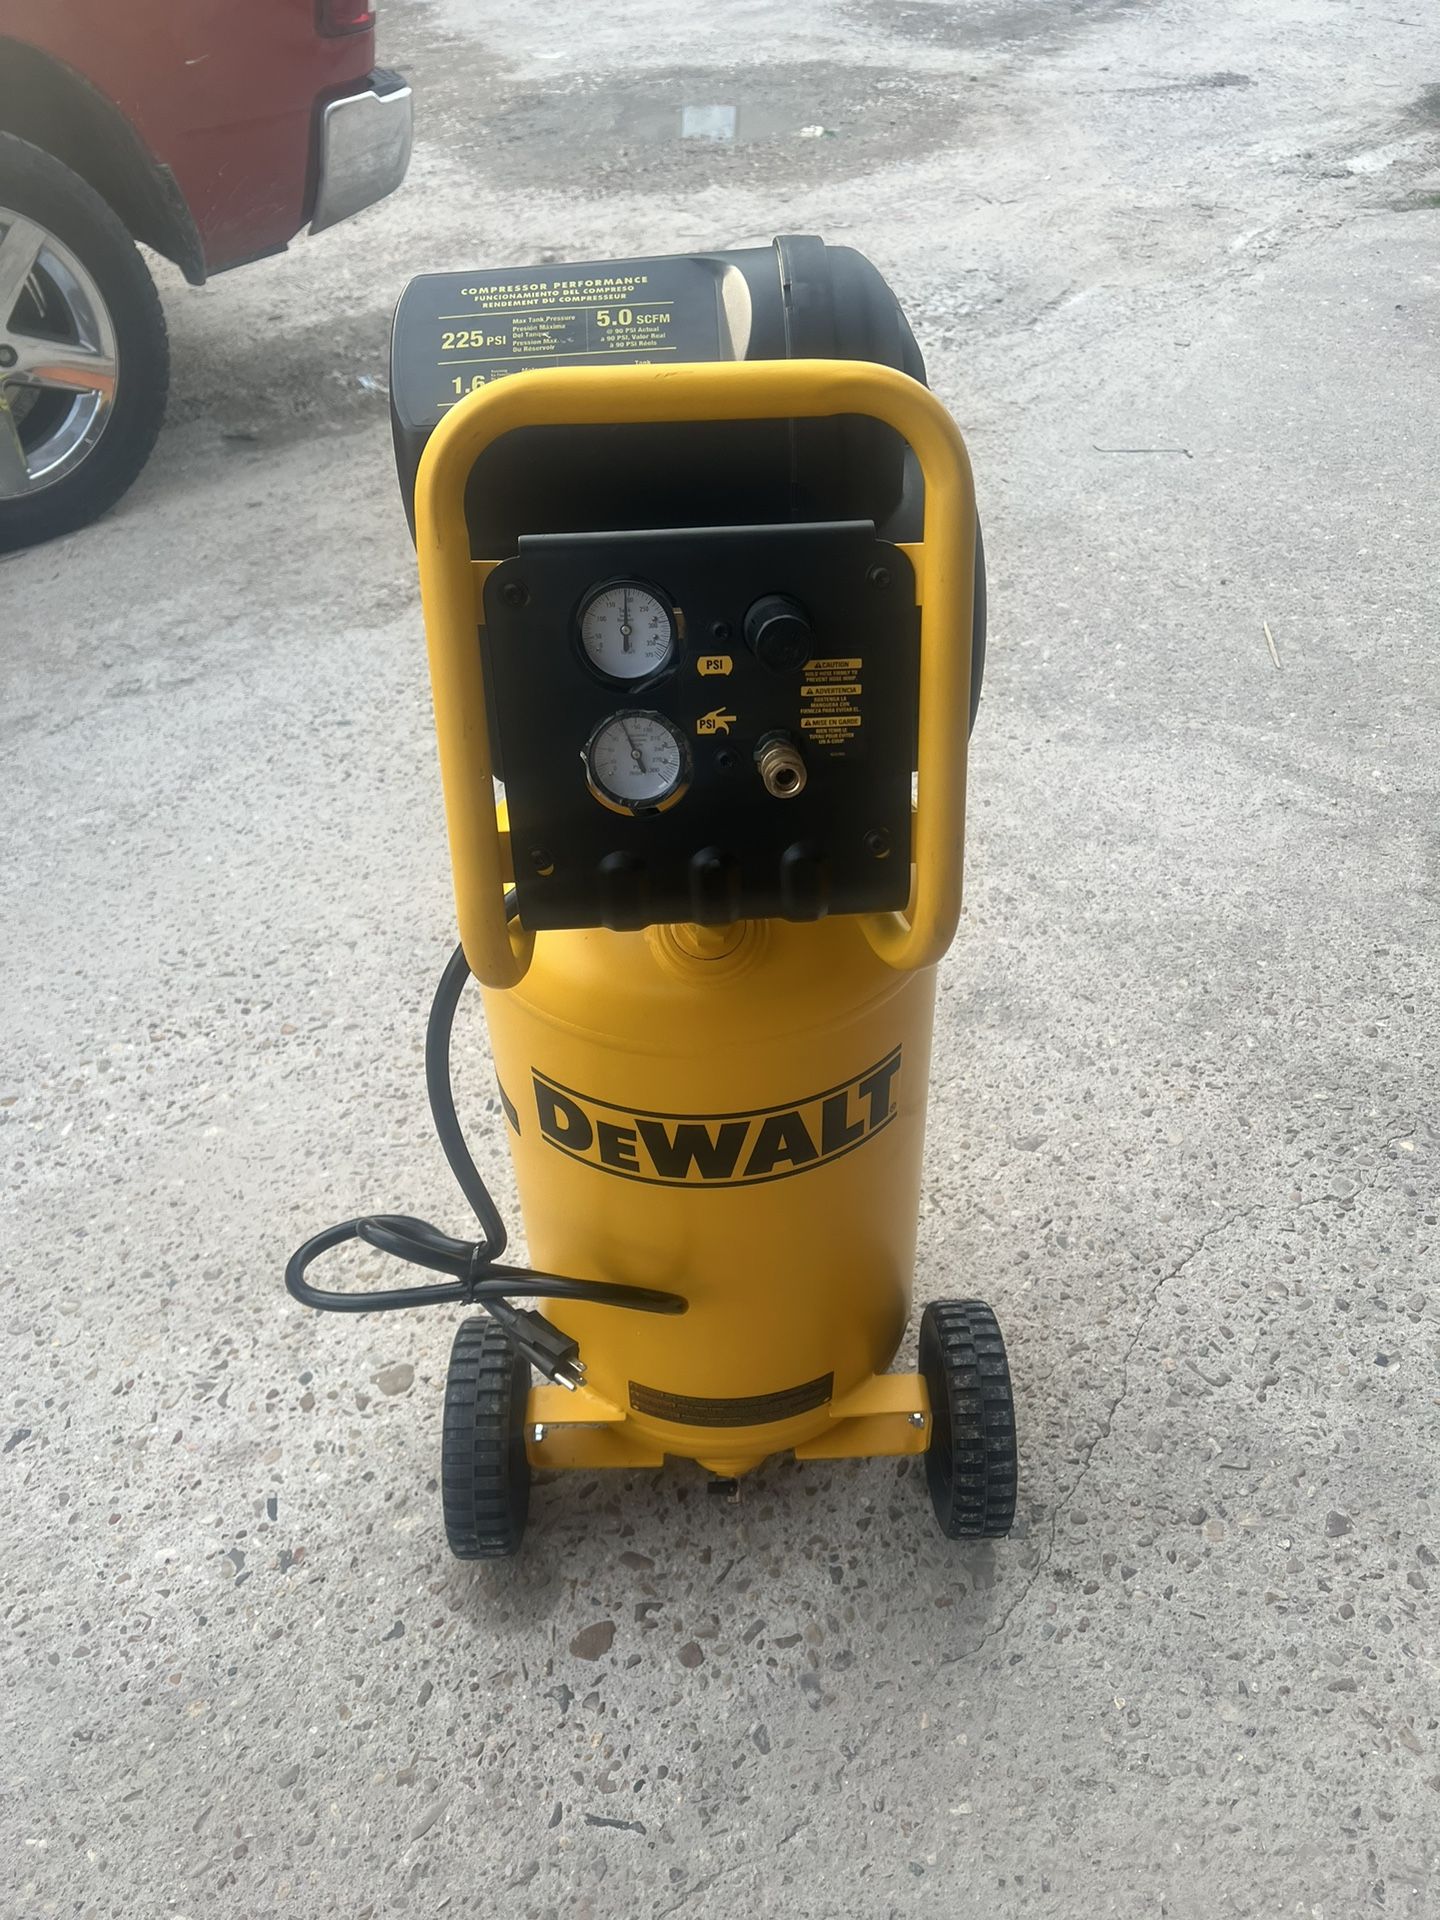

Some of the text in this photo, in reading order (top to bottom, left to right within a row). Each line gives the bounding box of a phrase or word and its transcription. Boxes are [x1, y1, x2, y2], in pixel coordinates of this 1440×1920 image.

[461, 277, 648, 295] COMPRESSOR PERFORMANCE
[475, 291, 559, 301] FUNCIONAMIENTO
[583, 286, 634, 294] COMPRESO
[483, 299, 538, 308] RENDEMENT
[559, 294, 626, 302] COMPRESSEUR
[597, 309, 670, 326] 5.0 SCFM
[442, 330, 506, 350] 225 PSI
[452, 376, 486, 394] 1.6
[707, 660, 722, 670] PSI
[700, 720, 715, 729] PSI
